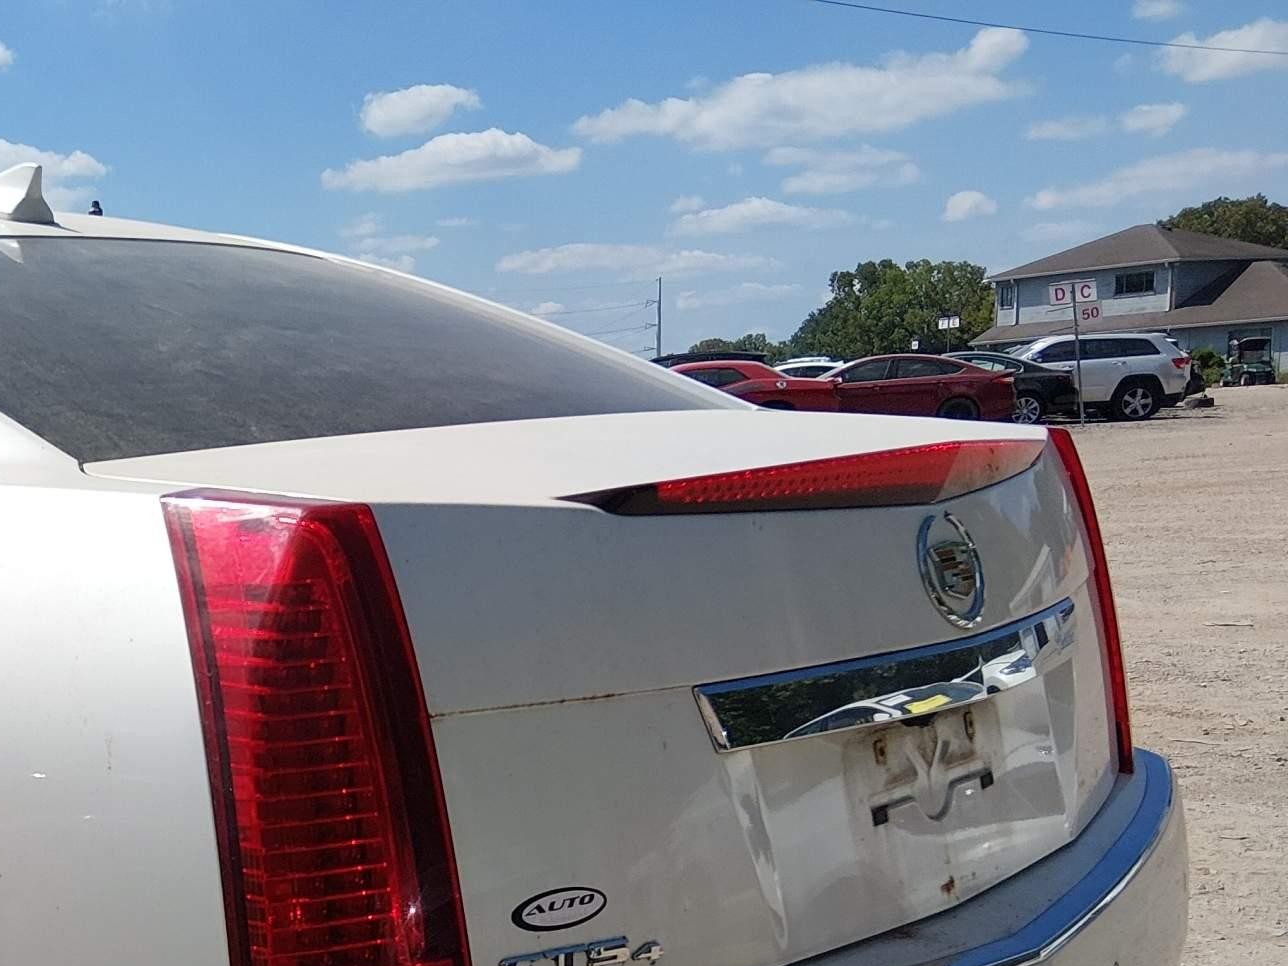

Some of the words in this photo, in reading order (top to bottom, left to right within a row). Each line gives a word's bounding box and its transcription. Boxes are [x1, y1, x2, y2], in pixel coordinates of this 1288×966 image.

[1054, 287, 1066, 302] D
[1080, 284, 1092, 299] C
[1081, 306, 1100, 321] 50
[524, 893, 596, 918] AUTO
